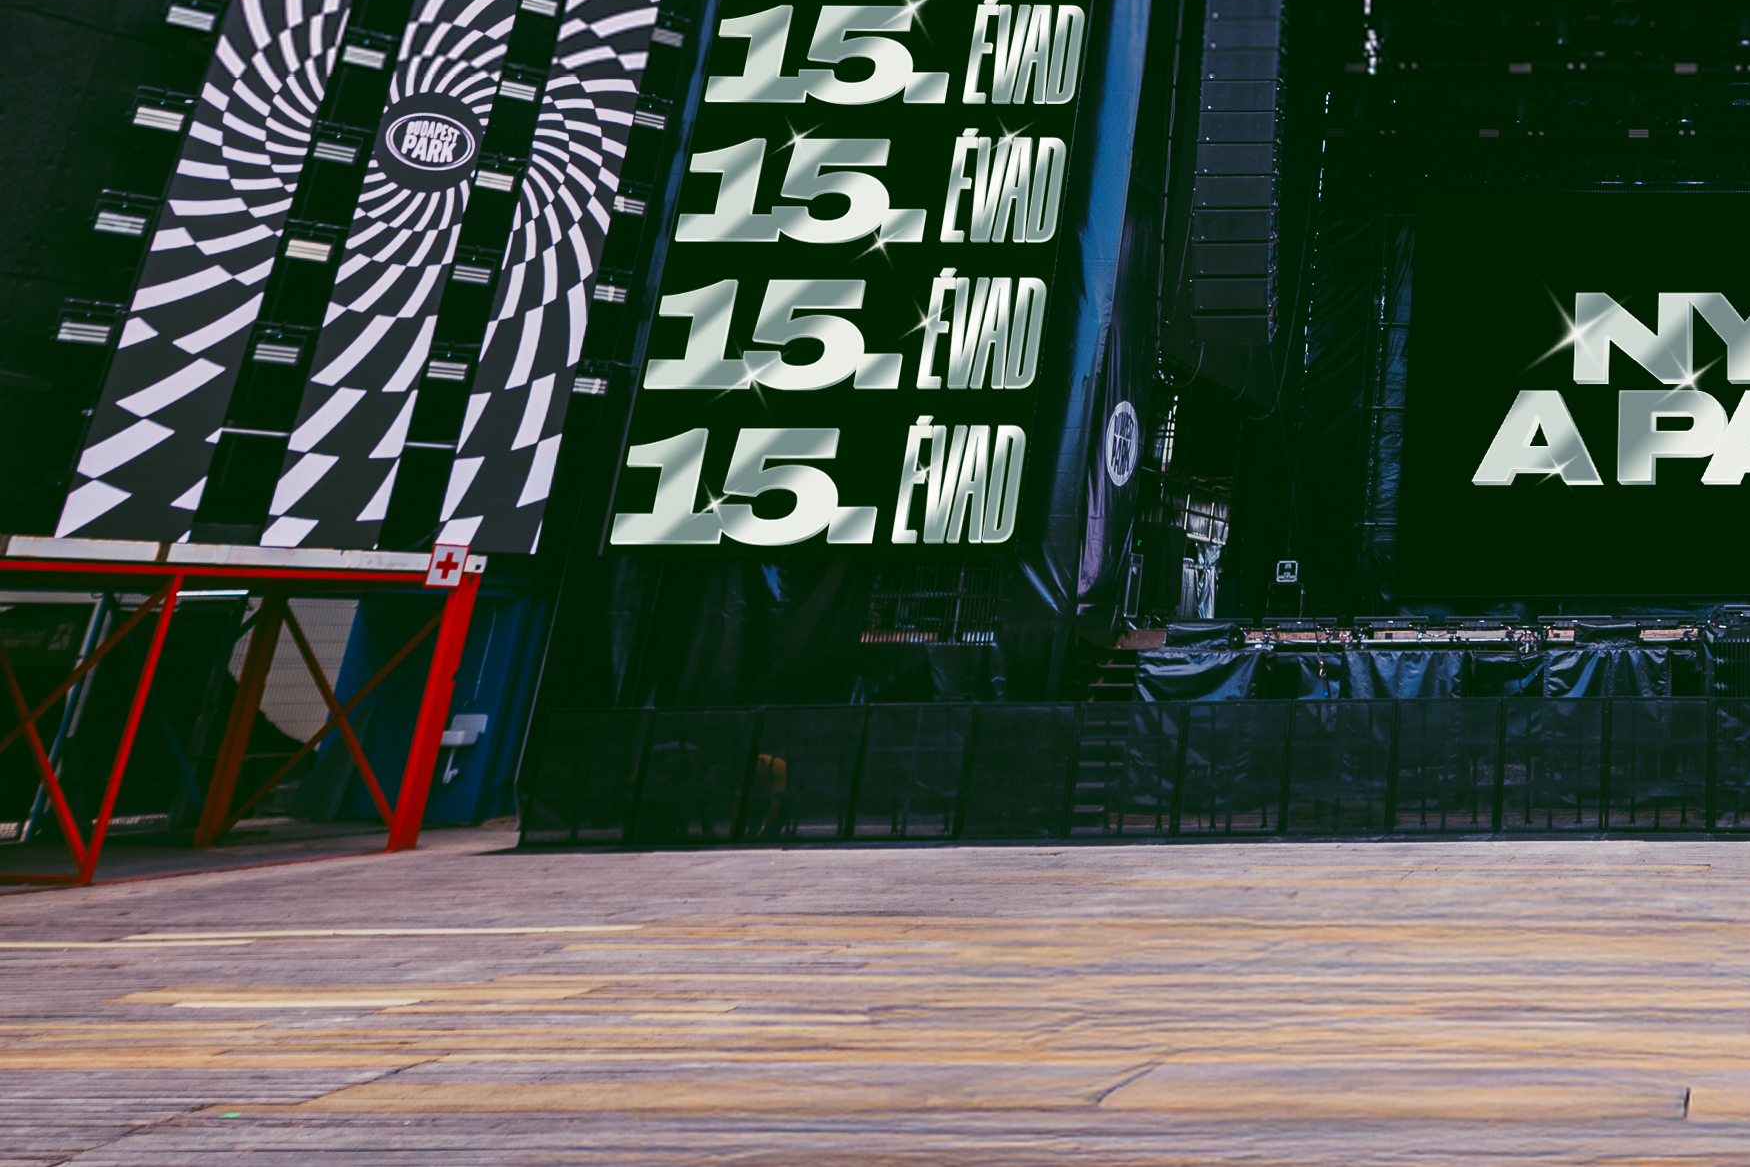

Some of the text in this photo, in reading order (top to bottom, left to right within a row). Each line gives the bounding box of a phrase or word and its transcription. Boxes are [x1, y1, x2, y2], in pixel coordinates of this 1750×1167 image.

[705, 5, 950, 105] 15.
[401, 134, 457, 163] PARK
[406, 120, 460, 144] BUDAPEST
[675, 128, 1067, 244] 15. ÉVAD
[643, 267, 1047, 391] 15. ÉVAD
[610, 415, 1027, 546] 15. ÉVAD
[1472, 389, 1604, 485] A
